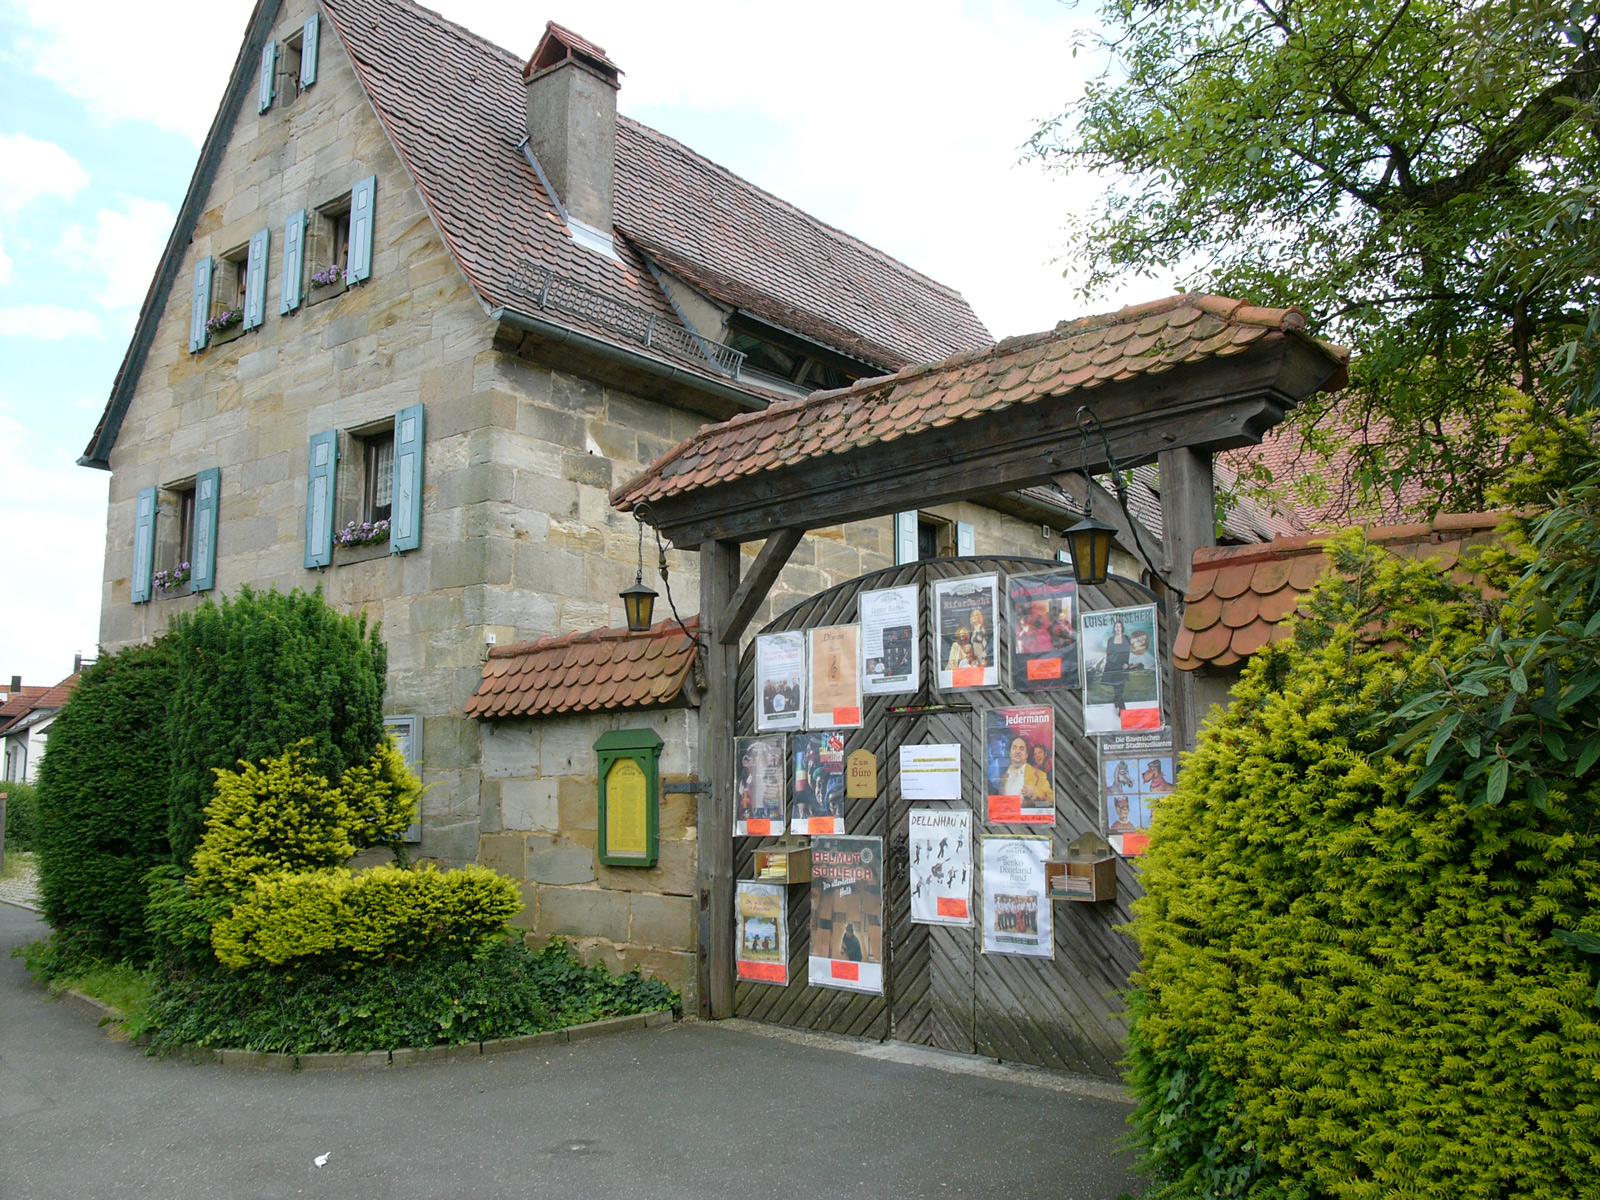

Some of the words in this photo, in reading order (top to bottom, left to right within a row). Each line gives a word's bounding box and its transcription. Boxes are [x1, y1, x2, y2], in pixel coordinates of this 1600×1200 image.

[1084, 615, 1108, 628] LUISE
[1110, 611, 1154, 626] KINSEHER
[1005, 714, 1050, 726] Jedermann
[1125, 734, 1160, 742] Bayerischen
[852, 758, 868, 766] Zum
[851, 767, 871, 777] Büro
[812, 851, 860, 864] HELMUT
[812, 865, 873, 880] SCHLEICH
